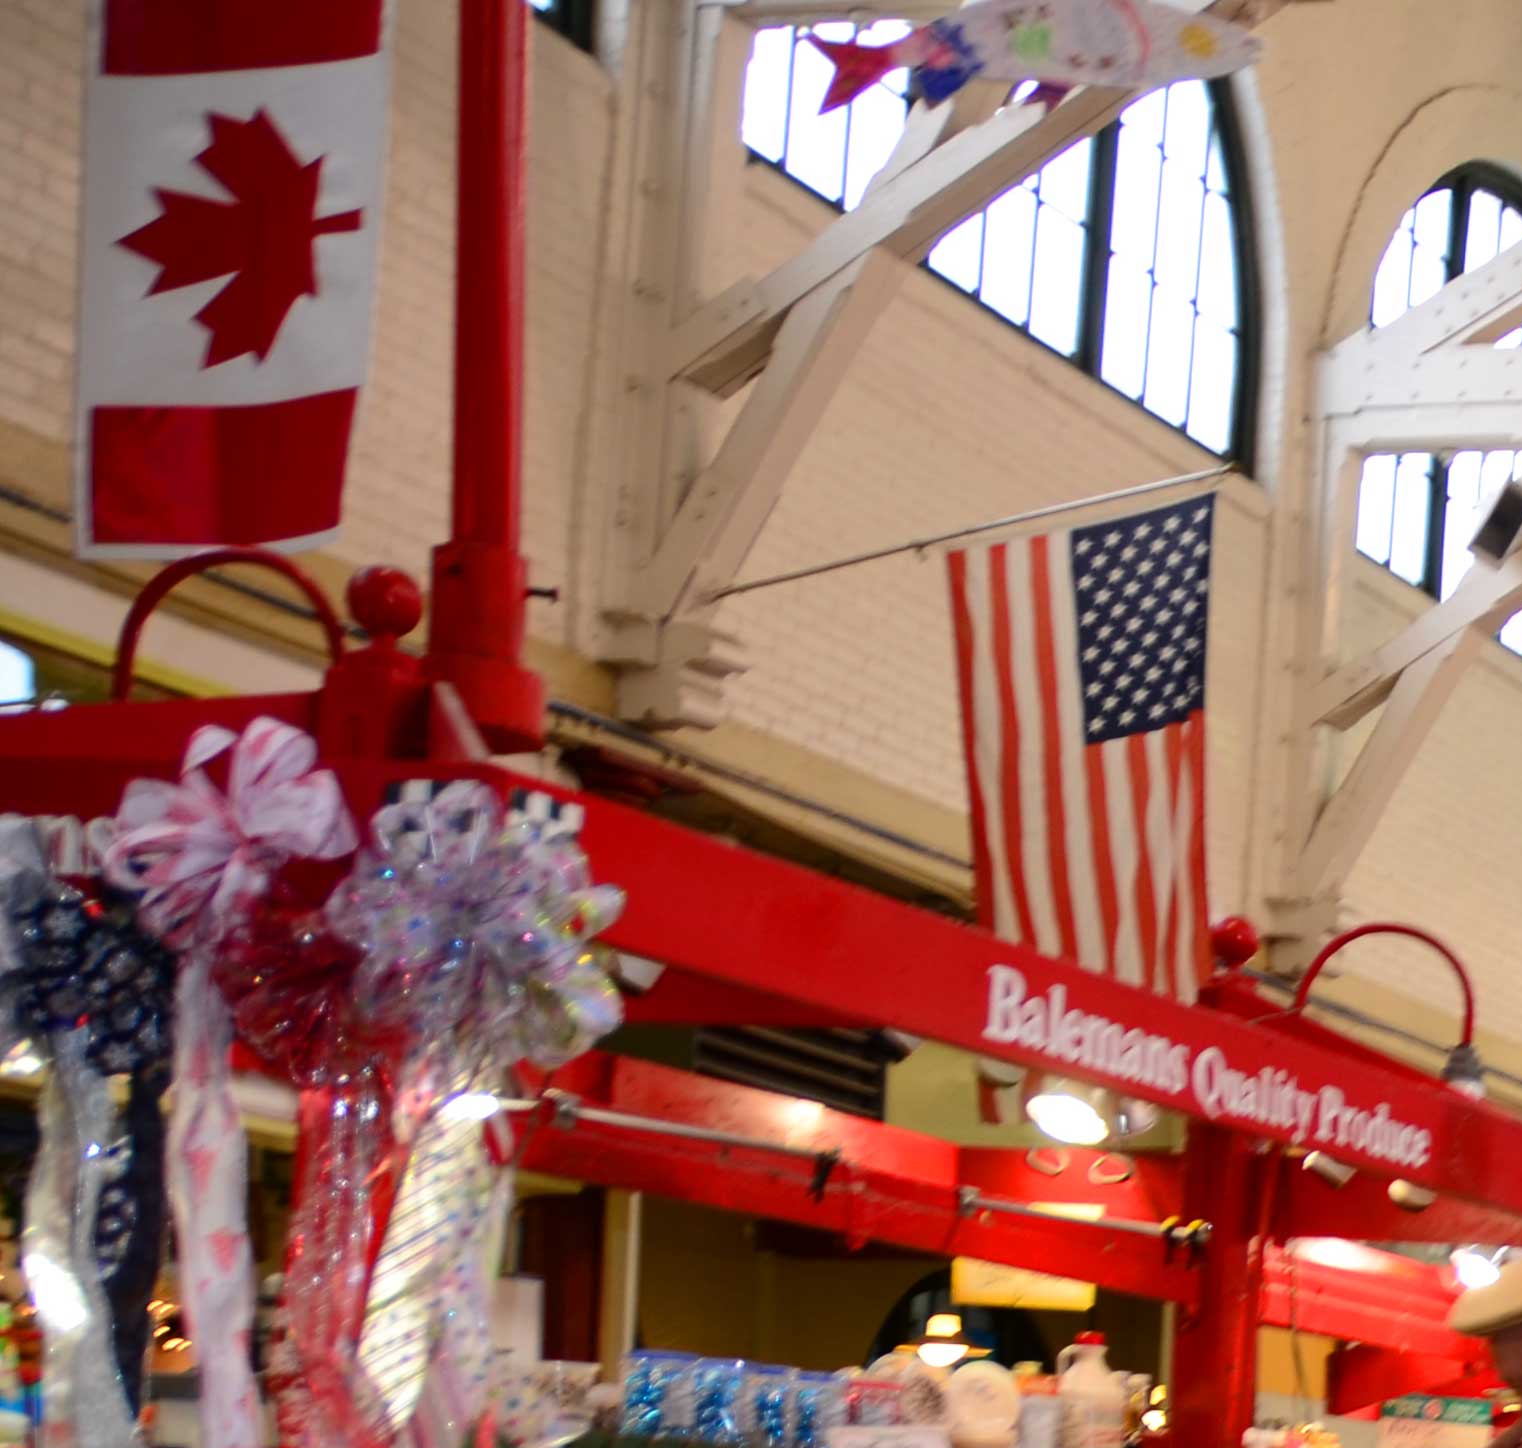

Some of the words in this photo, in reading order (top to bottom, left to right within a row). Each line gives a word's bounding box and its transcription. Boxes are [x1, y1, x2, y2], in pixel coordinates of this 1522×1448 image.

[981, 964, 1190, 1095] Balemans
[1192, 1046, 1317, 1141] Quality
[1314, 1085, 1432, 1169] Produce
